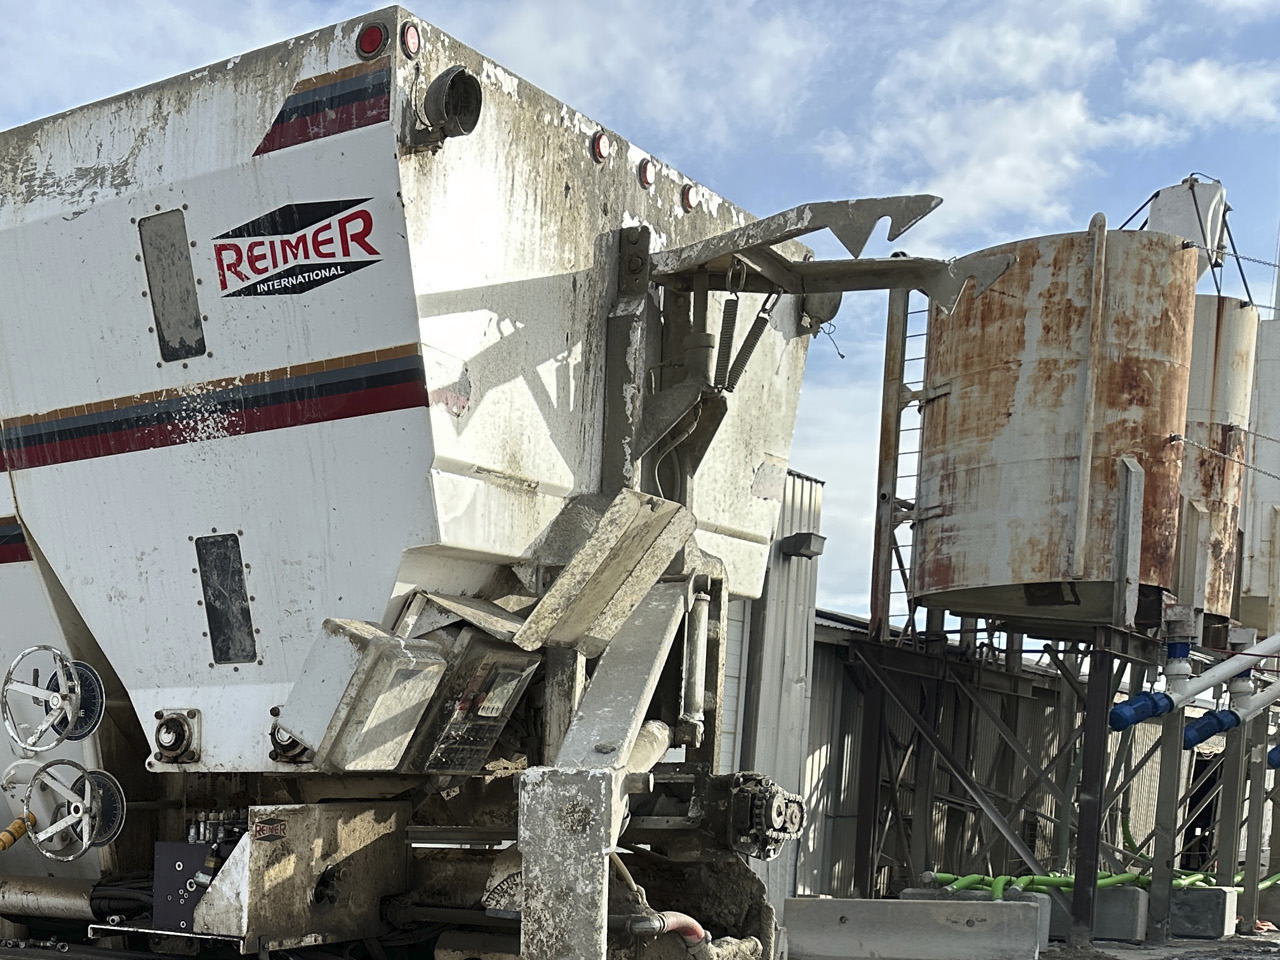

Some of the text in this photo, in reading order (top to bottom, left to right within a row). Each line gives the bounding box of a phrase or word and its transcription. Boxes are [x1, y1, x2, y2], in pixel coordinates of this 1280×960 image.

[214, 209, 381, 292] REIMER
[256, 265, 346, 293] INTERNATIONAL
[254, 822, 287, 838] REIMER
